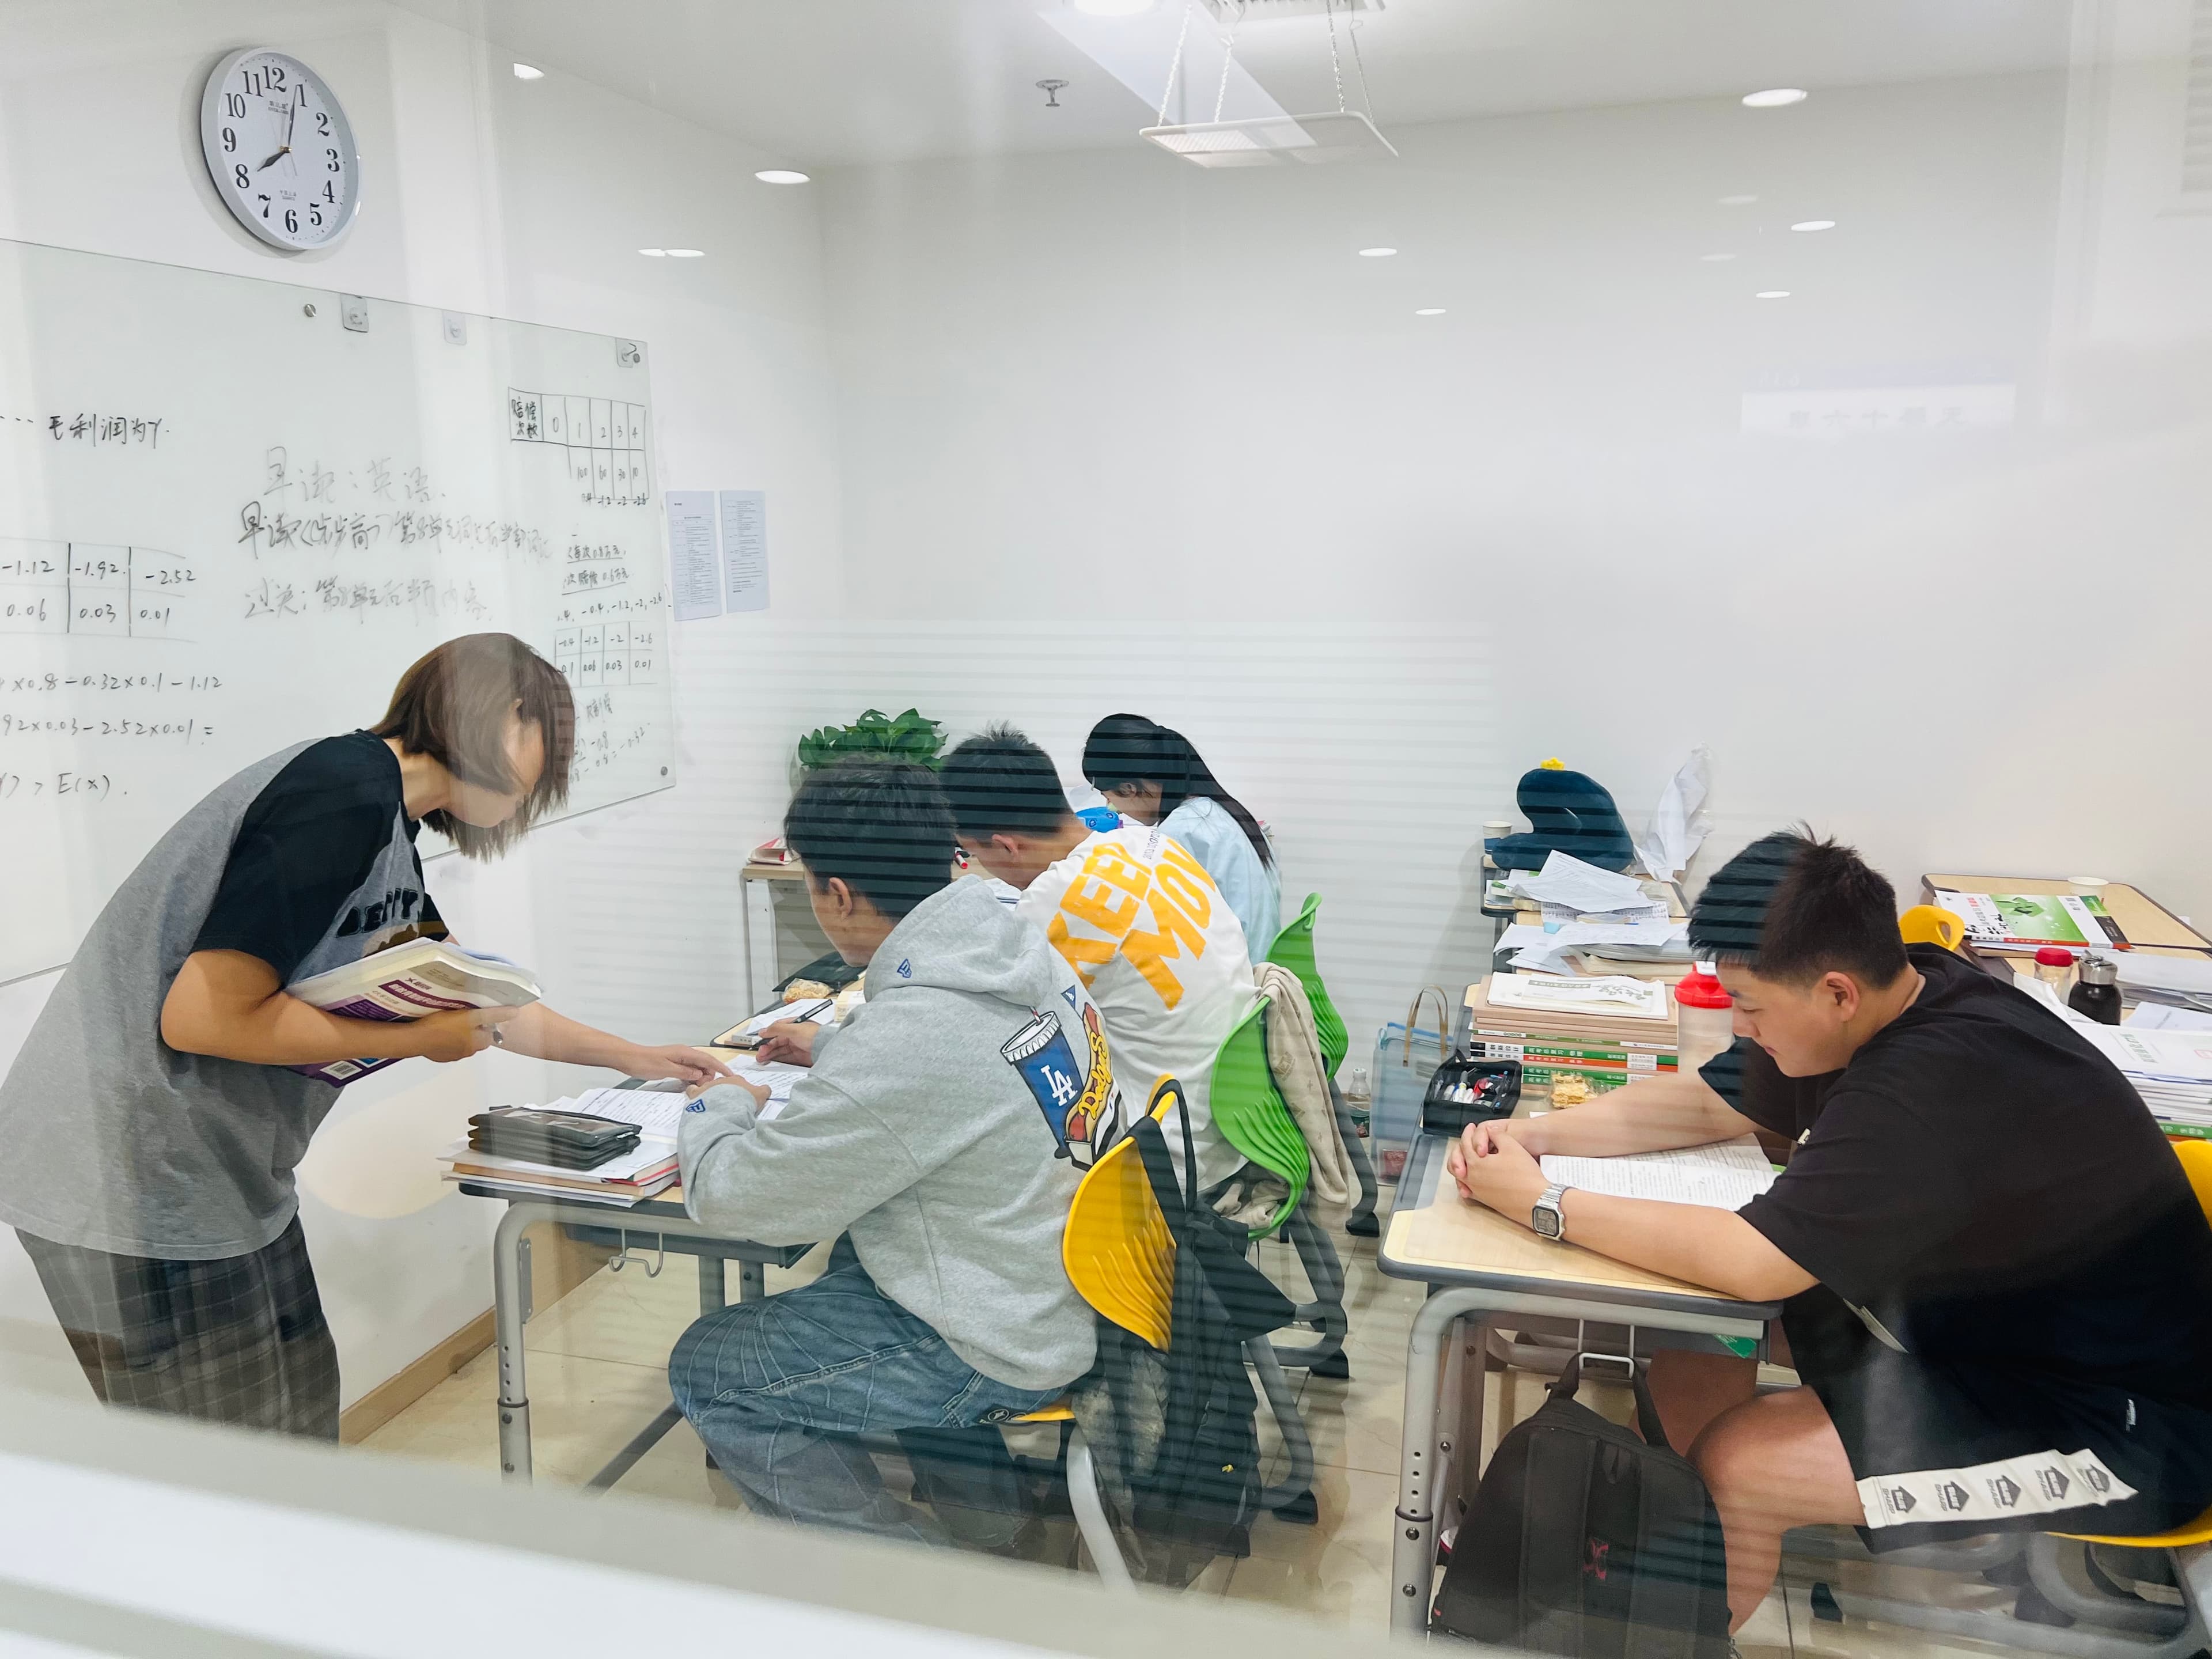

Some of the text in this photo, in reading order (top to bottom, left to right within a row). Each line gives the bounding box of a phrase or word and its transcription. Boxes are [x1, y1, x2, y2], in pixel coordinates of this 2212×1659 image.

[243, 70, 263, 97] 11
[262, 65, 286, 92] 12
[225, 93, 245, 119] 10
[296, 84, 308, 107] 1
[316, 112, 329, 136] 2
[222, 127, 236, 152] 9
[327, 149, 339, 172] 3
[236, 164, 249, 188] 8
[323, 180, 335, 203] 4
[258, 193, 271, 218] 7
[309, 203, 322, 226] 5
[285, 209, 298, 233] 6
[601, 427, 607, 438] 2
[617, 425, 623, 437] 3
[7, 599, 46, 621] 0.06
[80, 604, 116, 622] 0.03
[141, 608, 169, 626] 0.01
[606, 660, 622, 671] 0.03
[635, 659, 651, 671] 0.01
[1047, 842, 1152, 990] KEEP
[1040, 1065, 1078, 1107] LA
